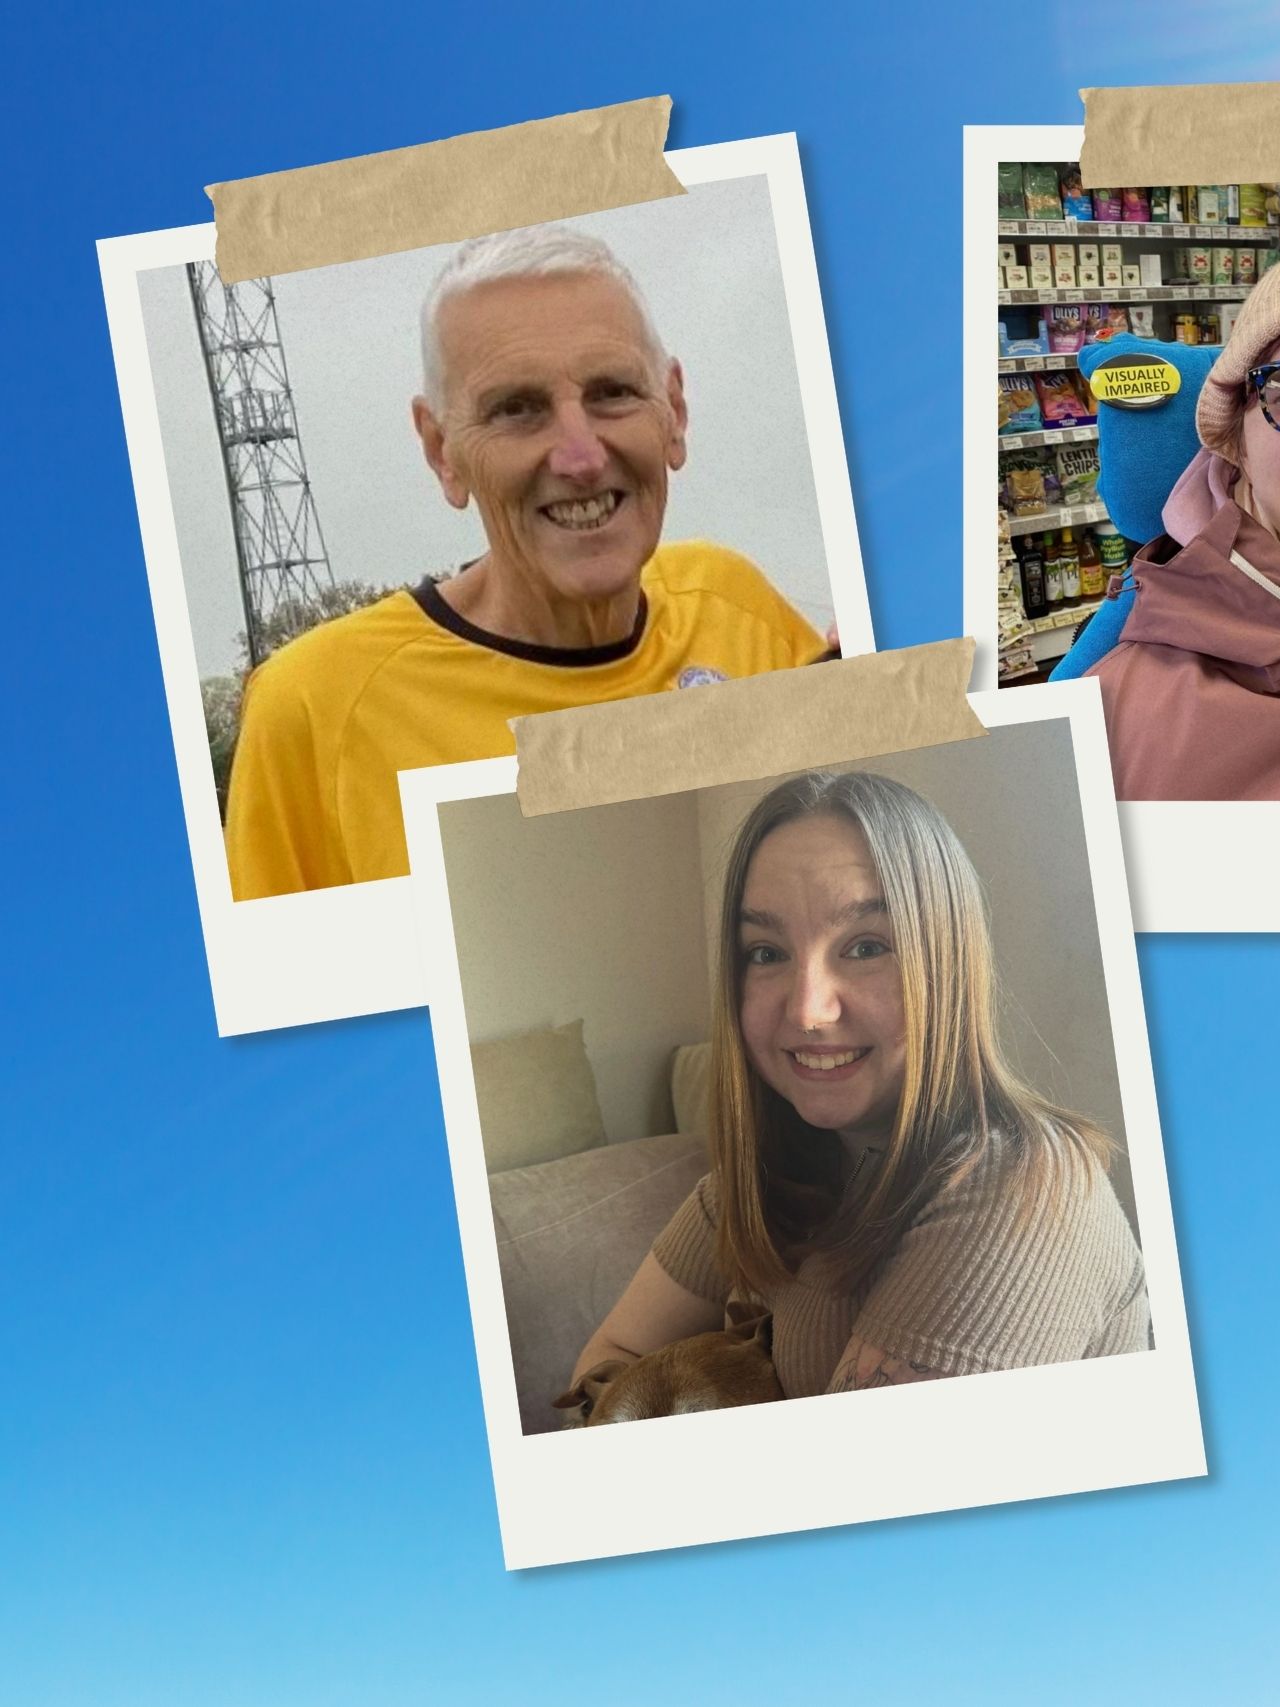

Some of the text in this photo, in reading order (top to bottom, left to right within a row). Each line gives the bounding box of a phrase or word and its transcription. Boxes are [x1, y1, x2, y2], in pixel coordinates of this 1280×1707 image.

[1105, 368, 1165, 383] VISUALLY
[1105, 381, 1170, 396] IMPAIRED
[1060, 448, 1098, 464] LENTIL
[1064, 459, 1100, 477] CHIPS
